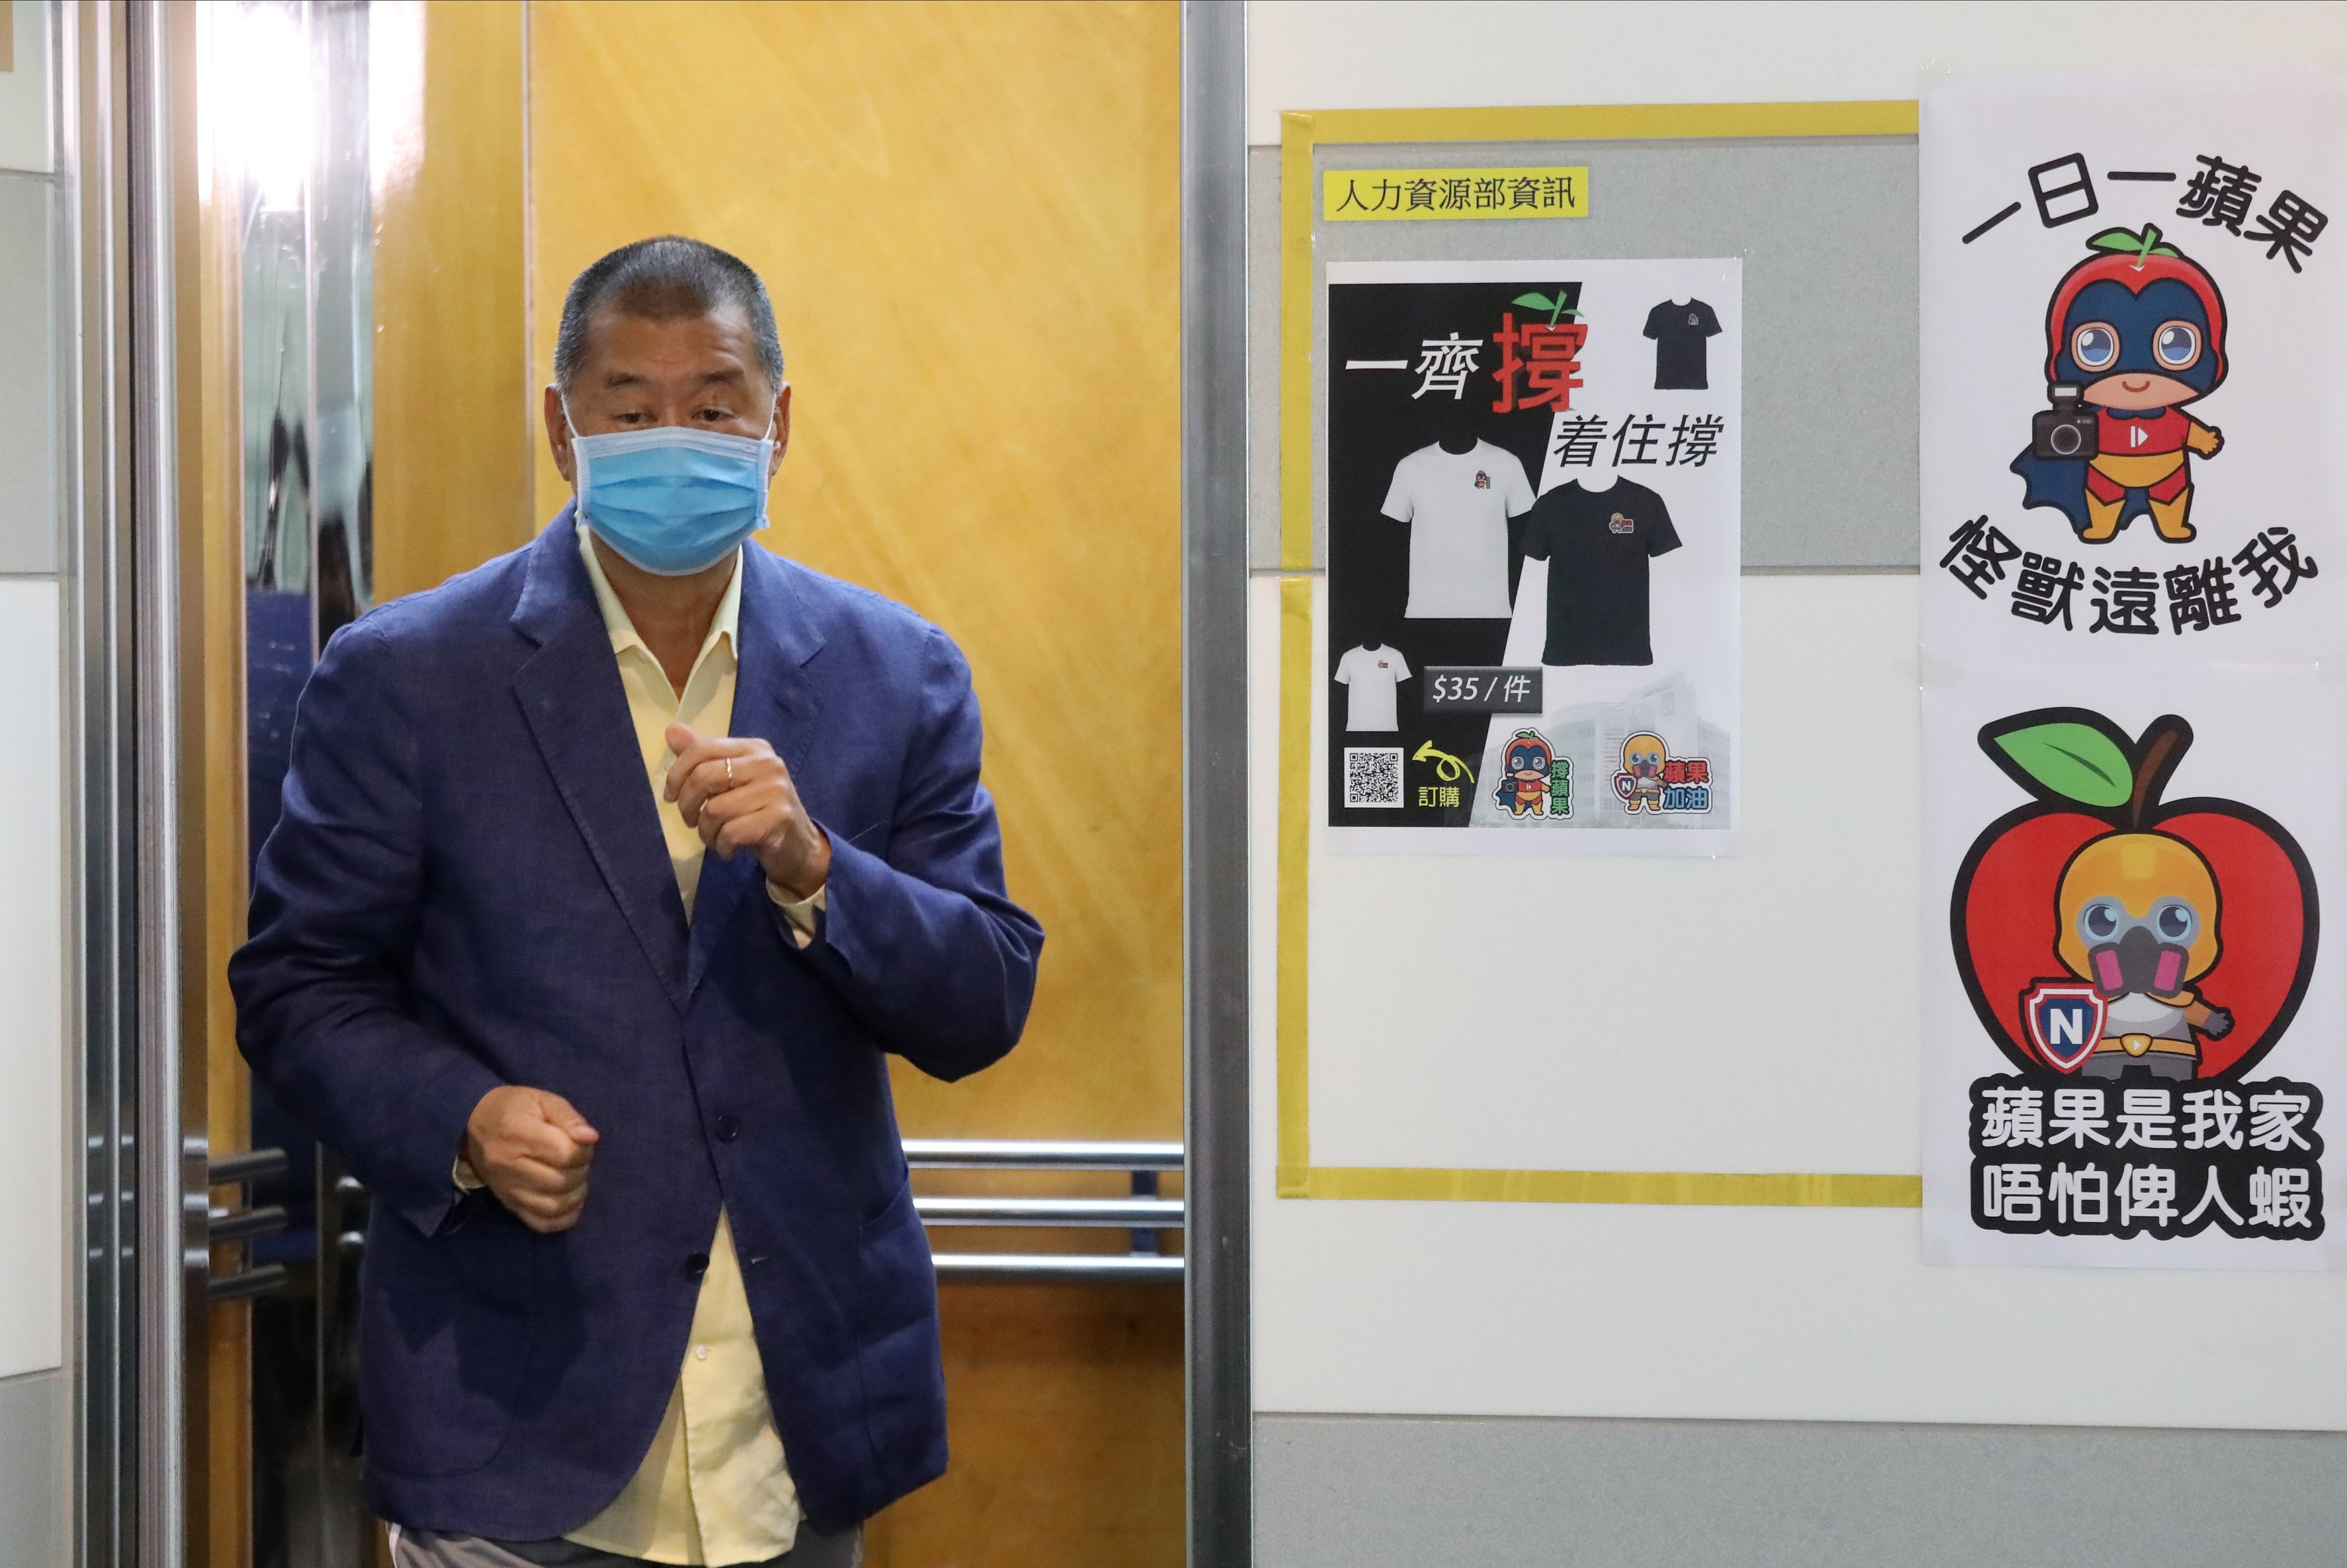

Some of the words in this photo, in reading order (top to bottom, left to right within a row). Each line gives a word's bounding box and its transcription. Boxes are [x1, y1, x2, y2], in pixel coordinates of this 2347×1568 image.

[1336, 176, 1575, 212] 人力資源部資訊
[1962, 152, 2328, 273] 一日一蘋果
[1552, 413, 1723, 468] 着住撐
[1939, 514, 2318, 635] 怪獸遠離我
[1432, 675, 1479, 703] $35
[1503, 675, 1531, 703] 件
[1621, 781, 1632, 791] N
[1664, 761, 1709, 784] 蘋果
[1418, 786, 1460, 807] 訂購
[1663, 786, 1709, 810] 加油
[2050, 1008, 2083, 1045] N
[1981, 1085, 2311, 1152] 蘋果是我家
[1982, 1162, 2312, 1228] 唔怕俾人蝦
